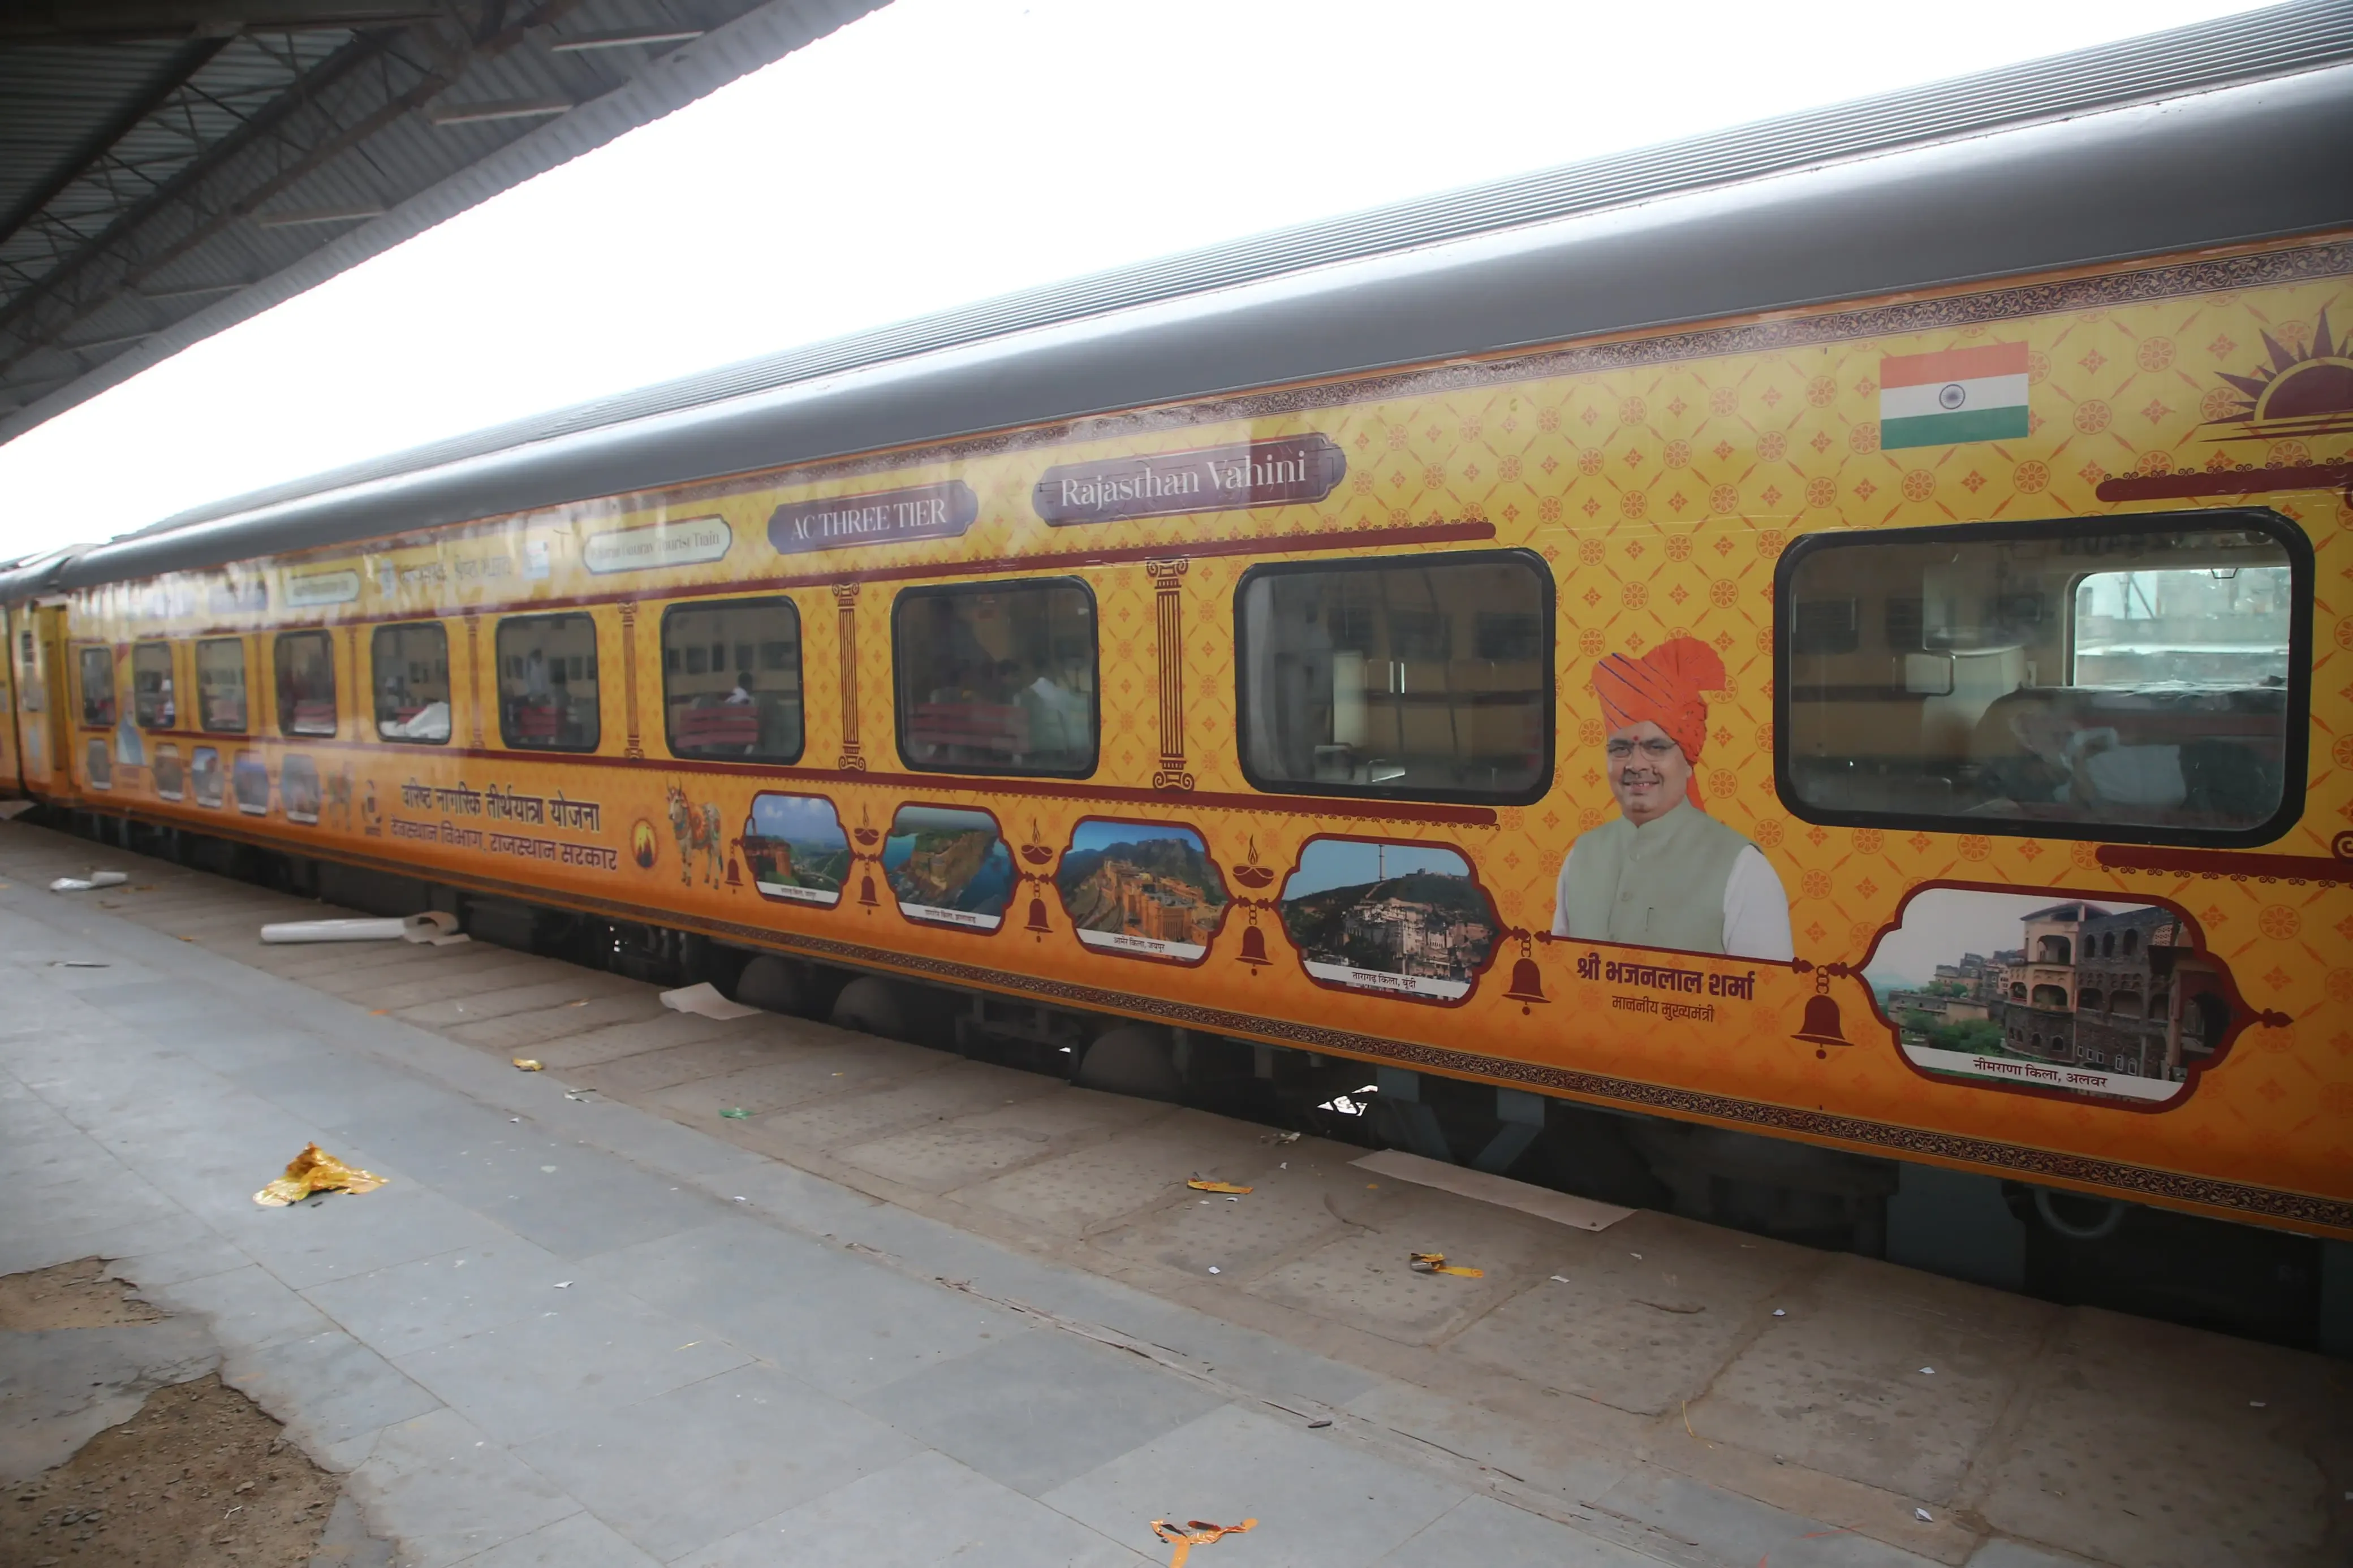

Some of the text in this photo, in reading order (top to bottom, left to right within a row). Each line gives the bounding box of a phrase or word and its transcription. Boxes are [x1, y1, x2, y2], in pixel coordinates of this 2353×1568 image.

[1061, 451, 1306, 511] Rajasthan Vahini
[791, 499, 947, 540] AC THREE TIER
[692, 530, 720, 547] Train
[402, 777, 600, 831] वरिष्ठ नागरिक तीर्थयात्रा योजना
[489, 833, 555, 860] राजस्थान
[559, 843, 617, 870] सरकार
[1130, 937, 1146, 949] किला,
[1147, 942, 1165, 952] जयपुर
[1352, 971, 1377, 983] तारागढ़
[1378, 973, 1400, 987] किला,
[1577, 952, 1755, 1000] श्री भजनलाल शर्मा
[1612, 995, 1714, 1022] माननीय मुख्यमंत्री
[1973, 1057, 2108, 1087] नीमराणा किला, अलवर
